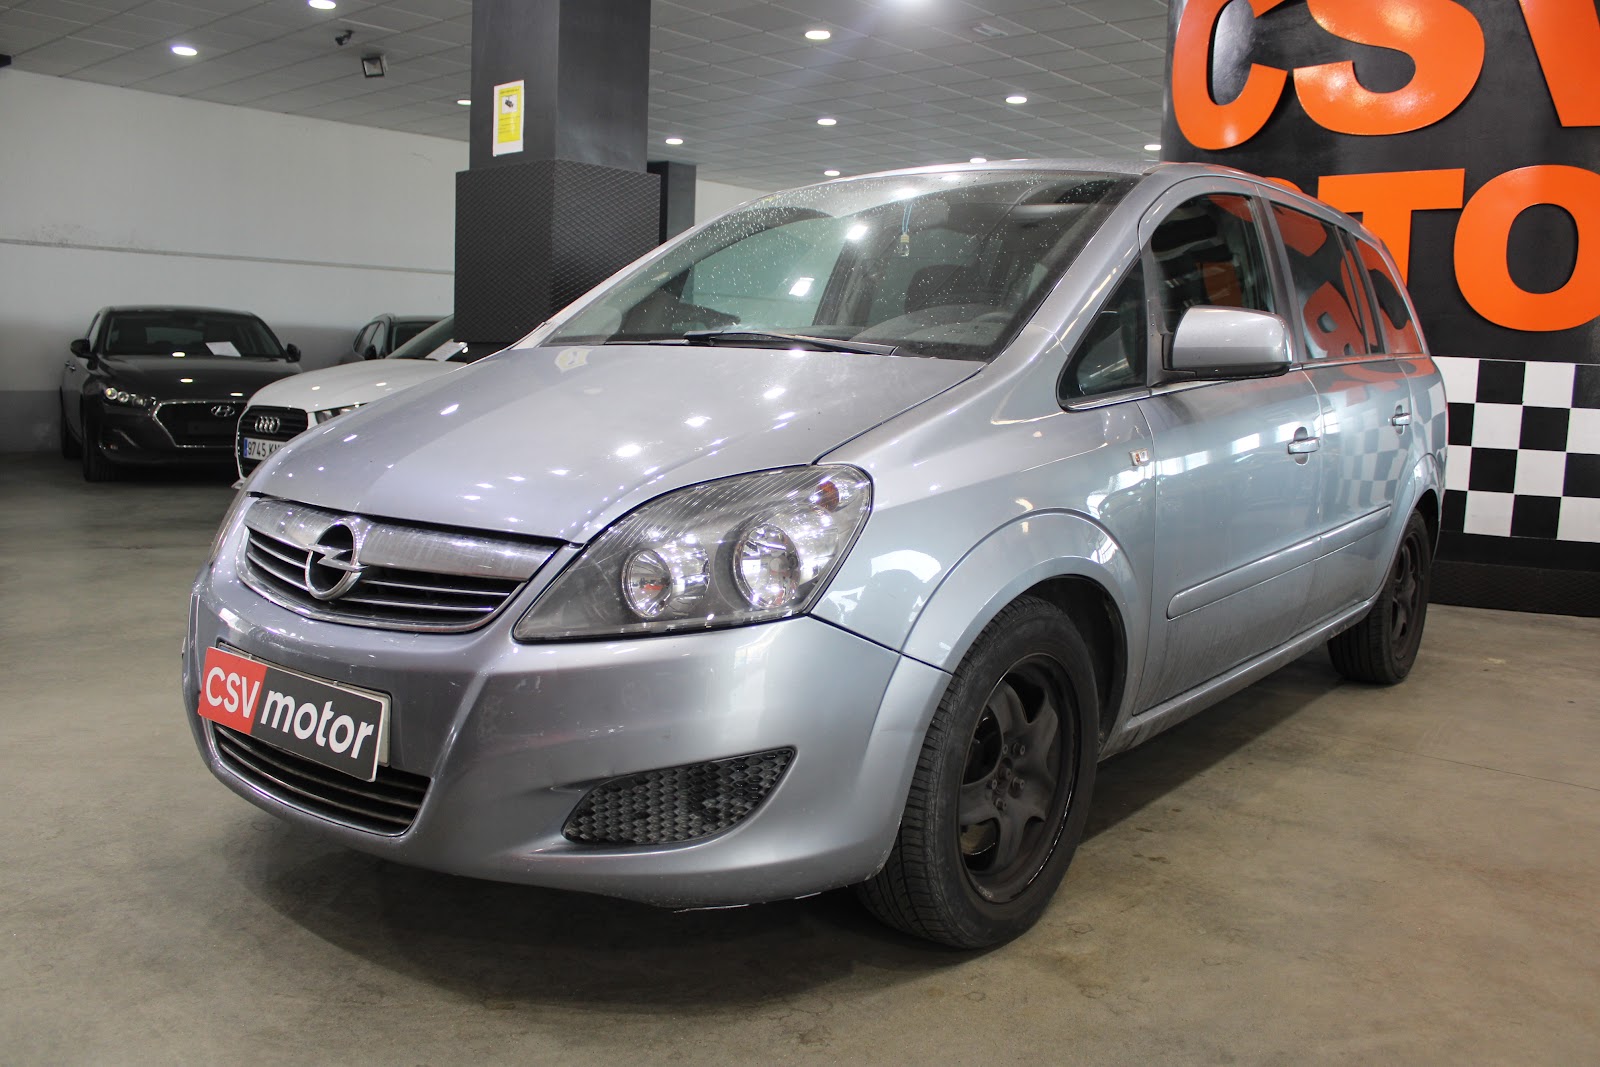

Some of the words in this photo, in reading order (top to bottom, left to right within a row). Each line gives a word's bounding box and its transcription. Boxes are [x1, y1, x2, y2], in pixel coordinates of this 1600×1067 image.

[1266, 164, 1600, 332] TO
[247, 441, 267, 458] 9745
[205, 666, 261, 719] CSV
[260, 690, 375, 759] motor
